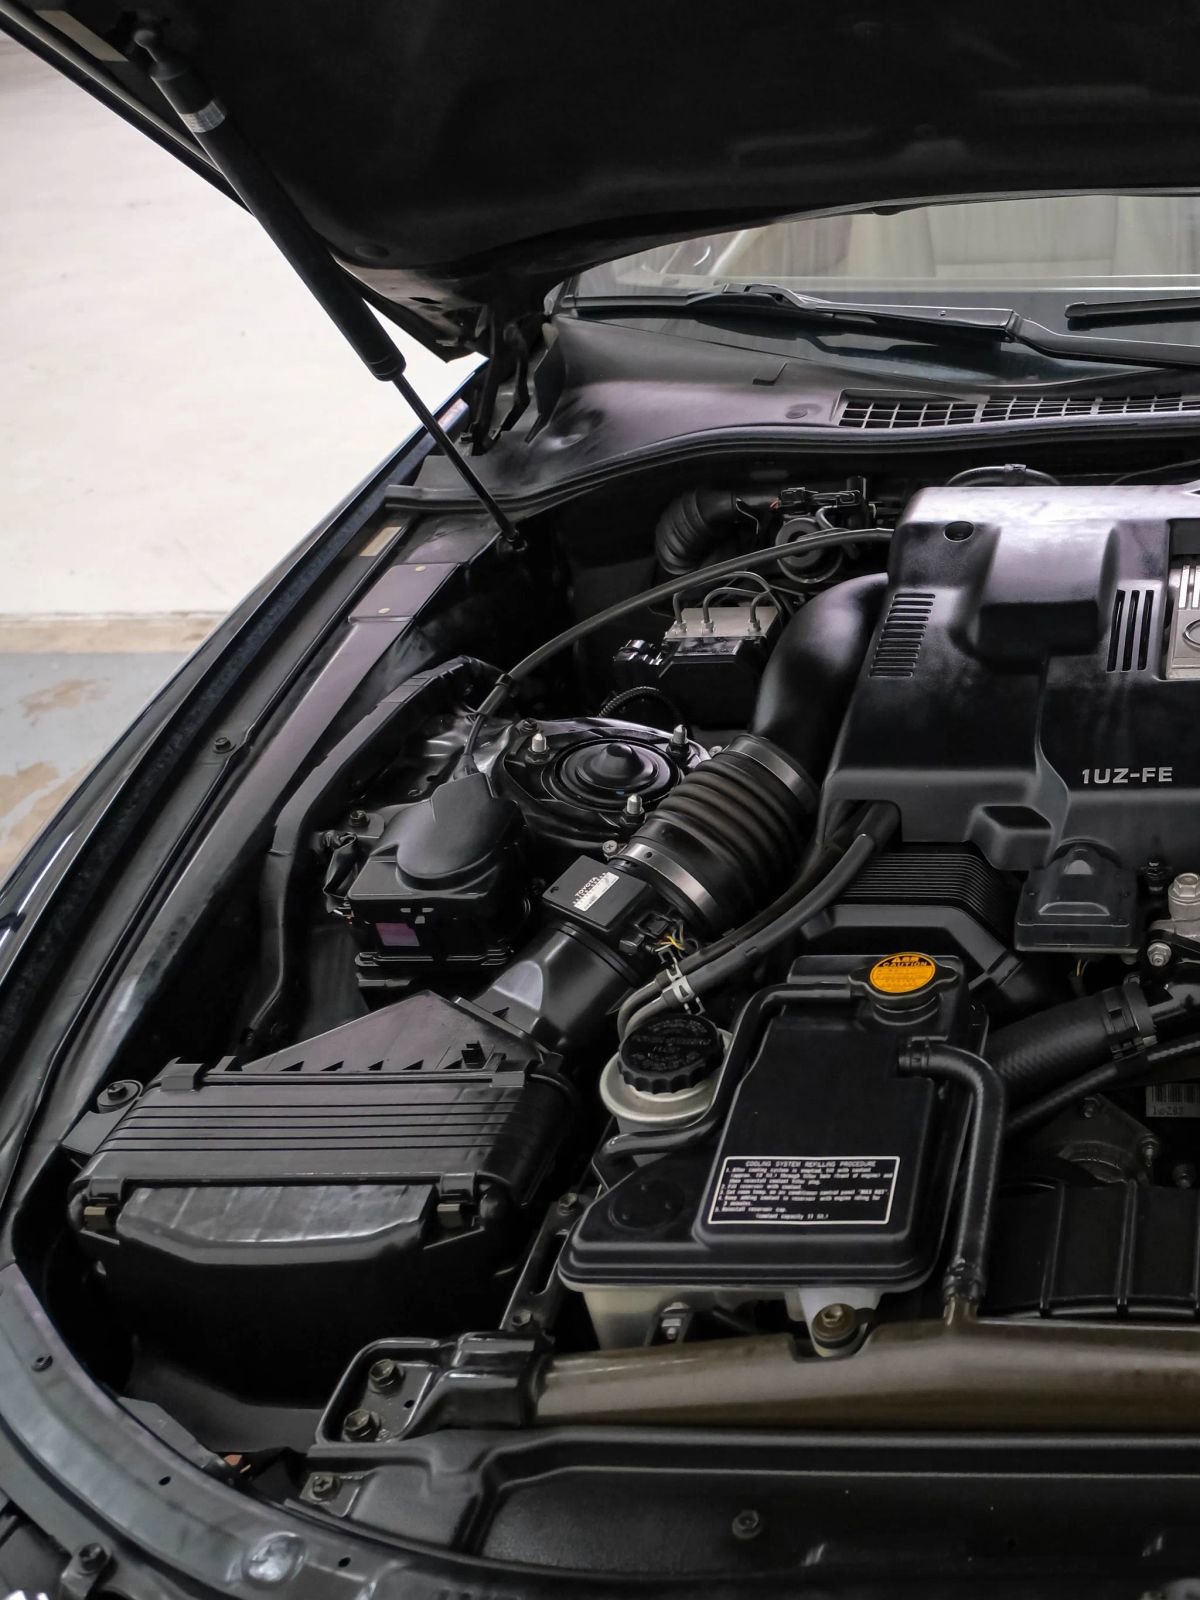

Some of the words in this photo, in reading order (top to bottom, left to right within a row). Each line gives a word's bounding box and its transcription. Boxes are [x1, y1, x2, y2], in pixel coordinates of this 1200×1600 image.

[1081, 766, 1174, 784] 1UZ-FE
[574, 876, 599, 897] TOYOTA
[775, 1160, 801, 1168] SYSTEM
